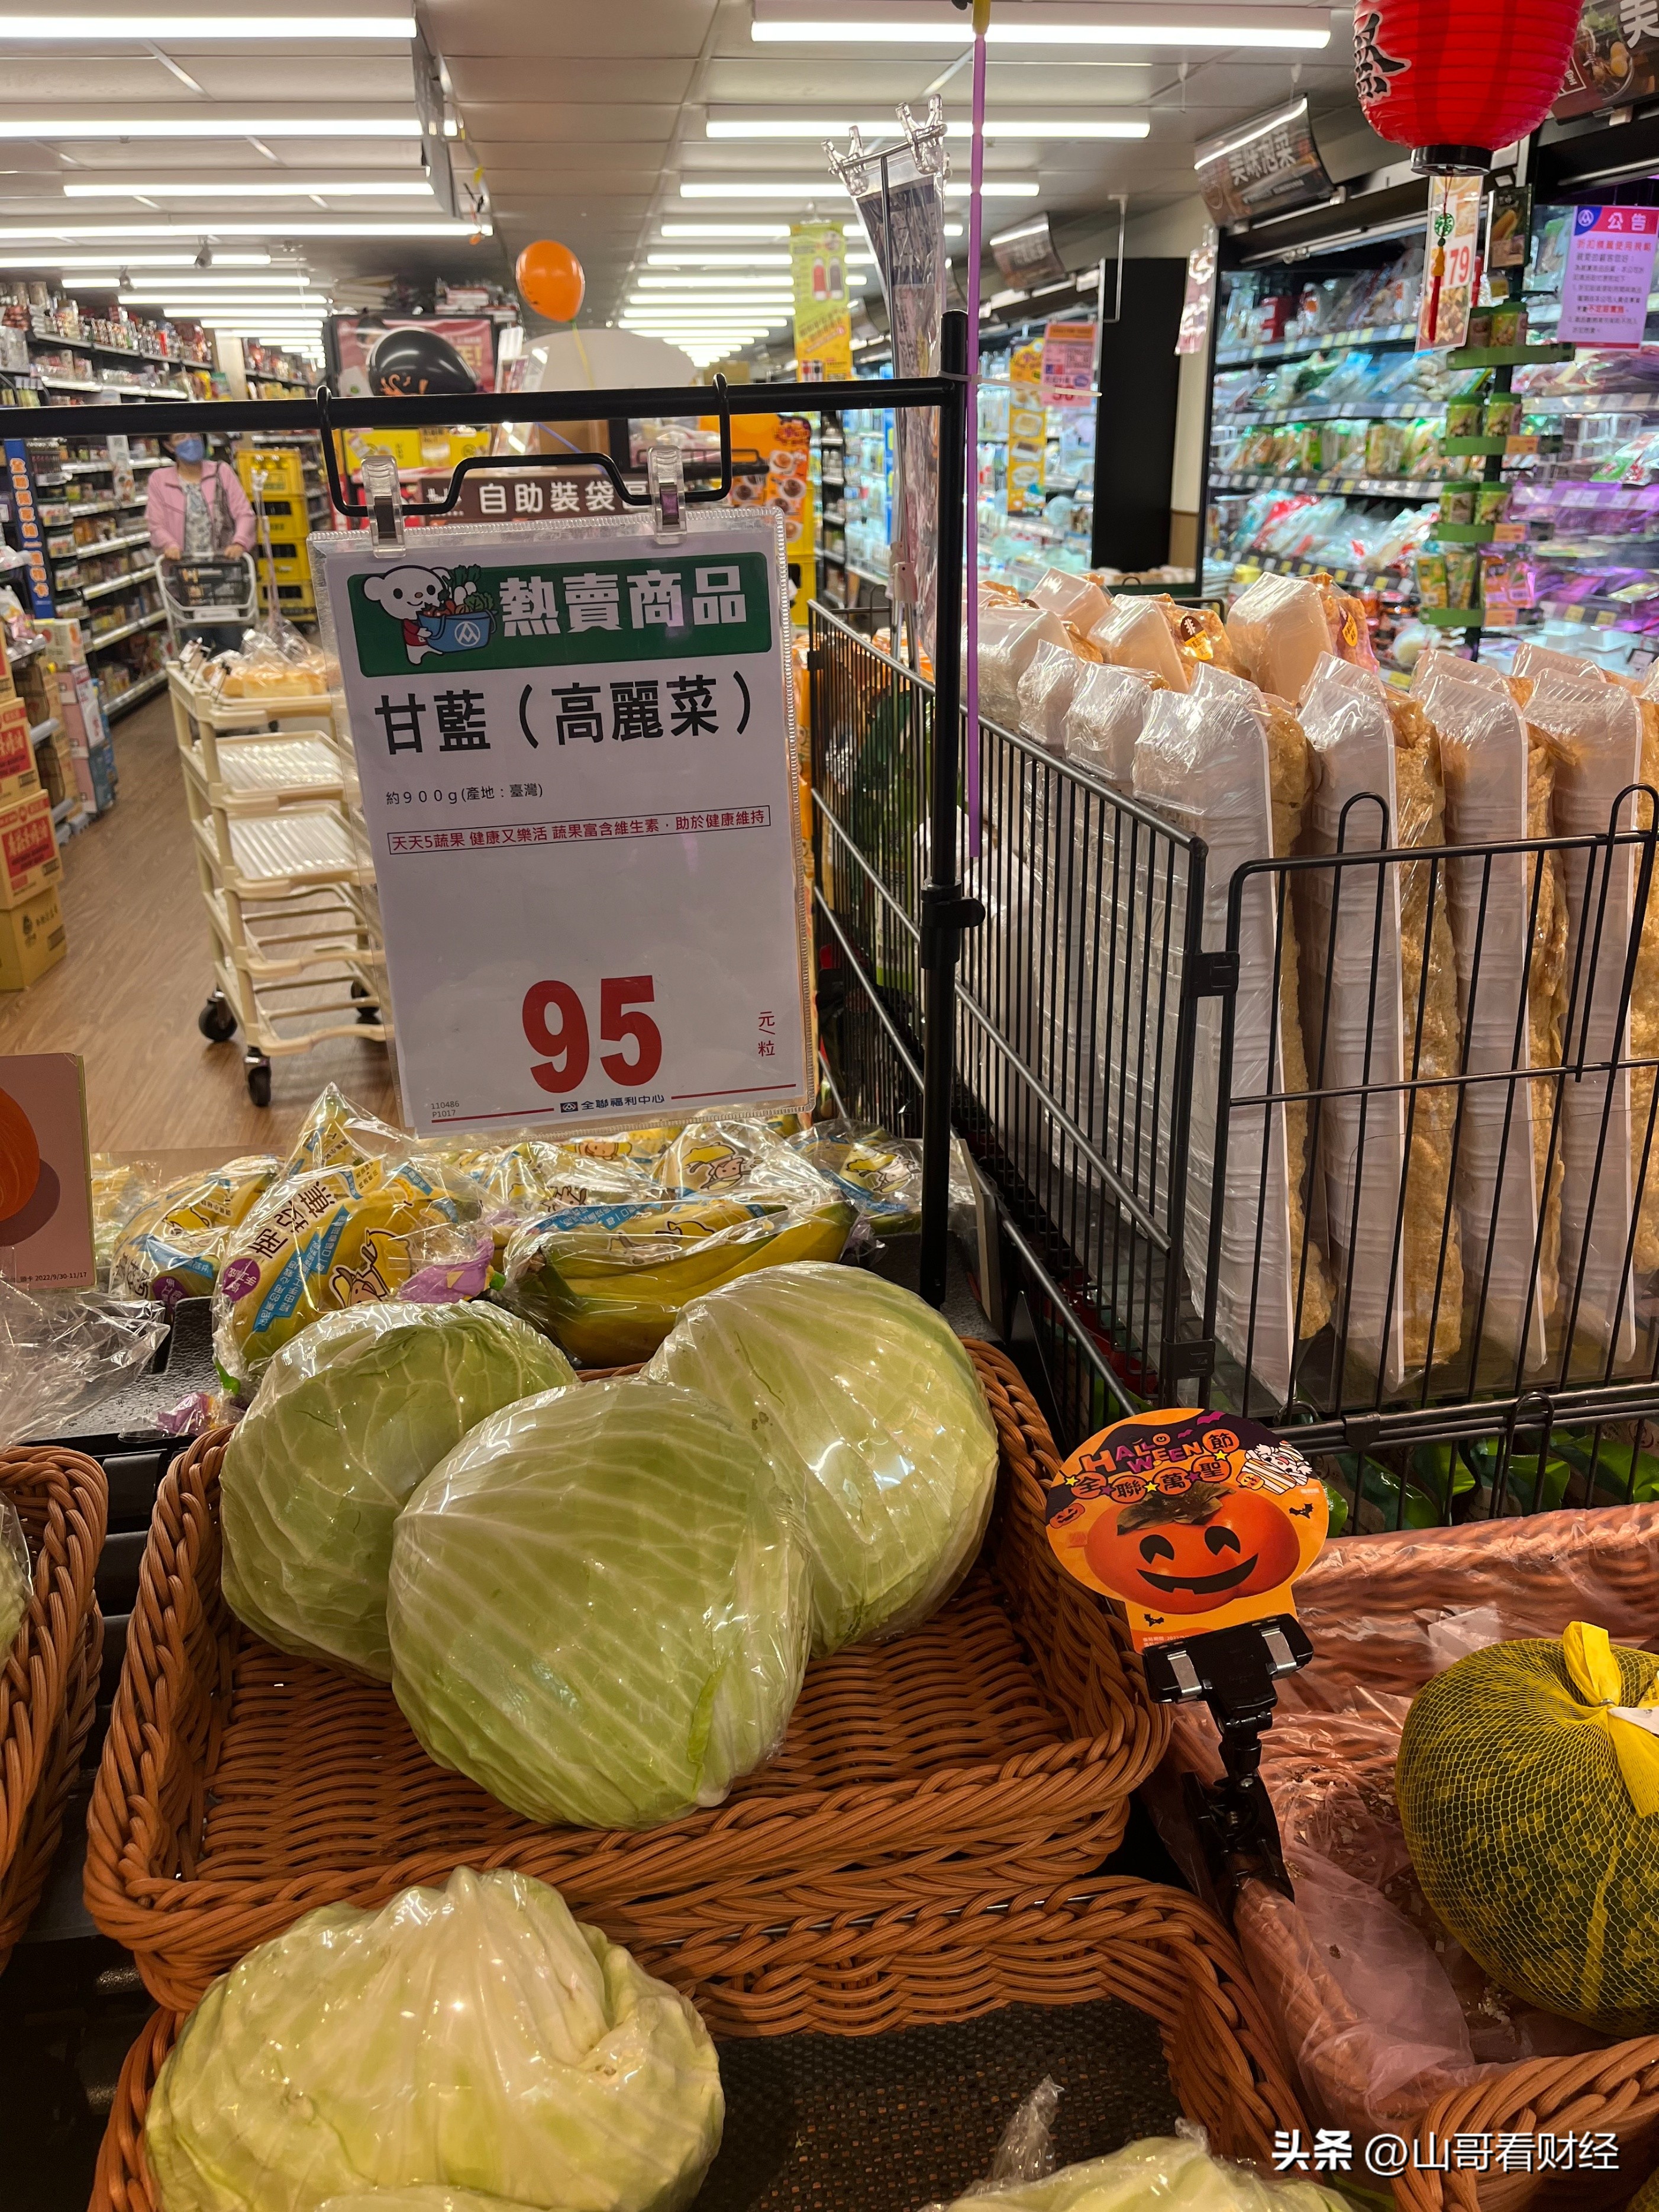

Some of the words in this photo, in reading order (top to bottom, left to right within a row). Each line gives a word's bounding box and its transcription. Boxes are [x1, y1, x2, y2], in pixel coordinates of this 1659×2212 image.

[1608, 211, 1647, 231] 公告
[500, 565, 747, 637] 熱賣商品
[374, 670, 751, 756] 甘藍（高麗菜）
[392, 834, 465, 851] 天天5蔬果
[470, 827, 547, 846] 健康又樂活
[524, 975, 662, 1093] 95
[431, 1101, 460, 1110] 110486
[581, 1094, 666, 1111] 全聯福利中心
[432, 1110, 457, 1118] P1017
[247, 1181, 336, 1259] 南投蕉
[35, 1272, 87, 1281] 2022/9/30-11/17
